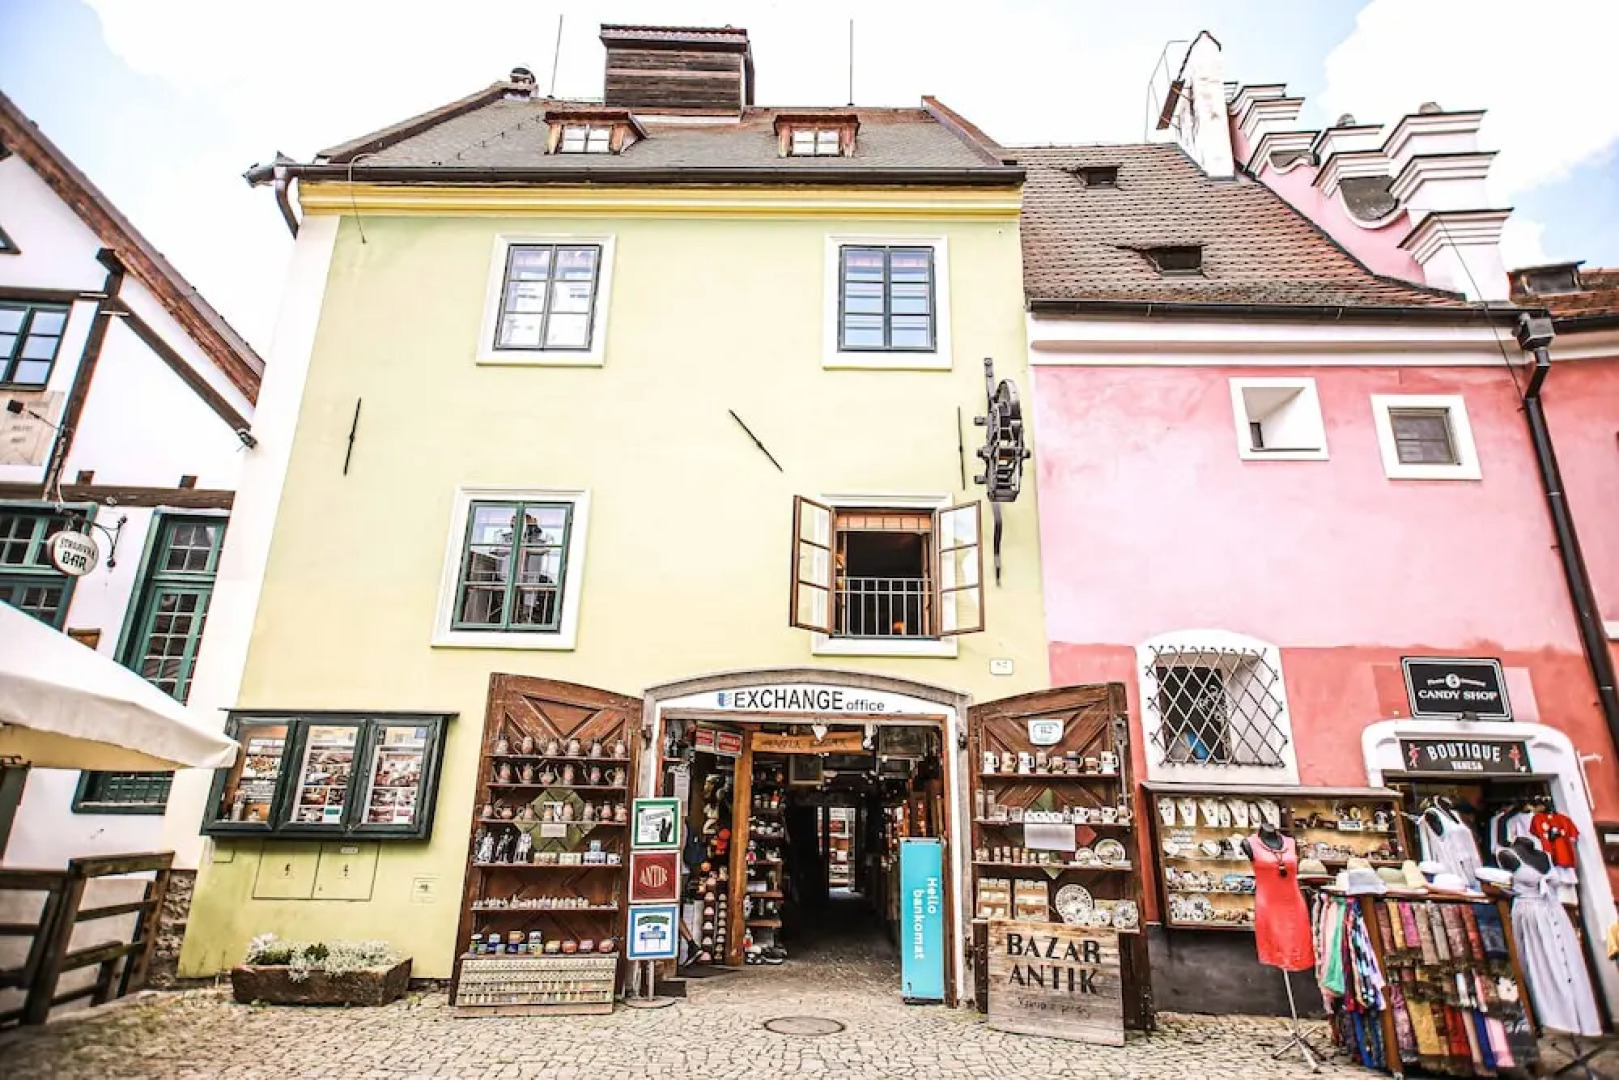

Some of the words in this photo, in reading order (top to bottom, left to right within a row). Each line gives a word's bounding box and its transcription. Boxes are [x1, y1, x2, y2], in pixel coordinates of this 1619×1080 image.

[63, 551, 86, 571] BAR
[734, 689, 843, 710] EXCHANGE
[846, 699, 885, 712] office
[1418, 690, 1460, 700] CANDY
[1463, 691, 1498, 701] SHOP
[1427, 743, 1501, 763] BOUTIQUE
[927, 877, 940, 914] Hello
[913, 889, 926, 960] bankomat
[1006, 933, 1101, 964] BAZAR
[1008, 962, 1099, 994] ANTIK
